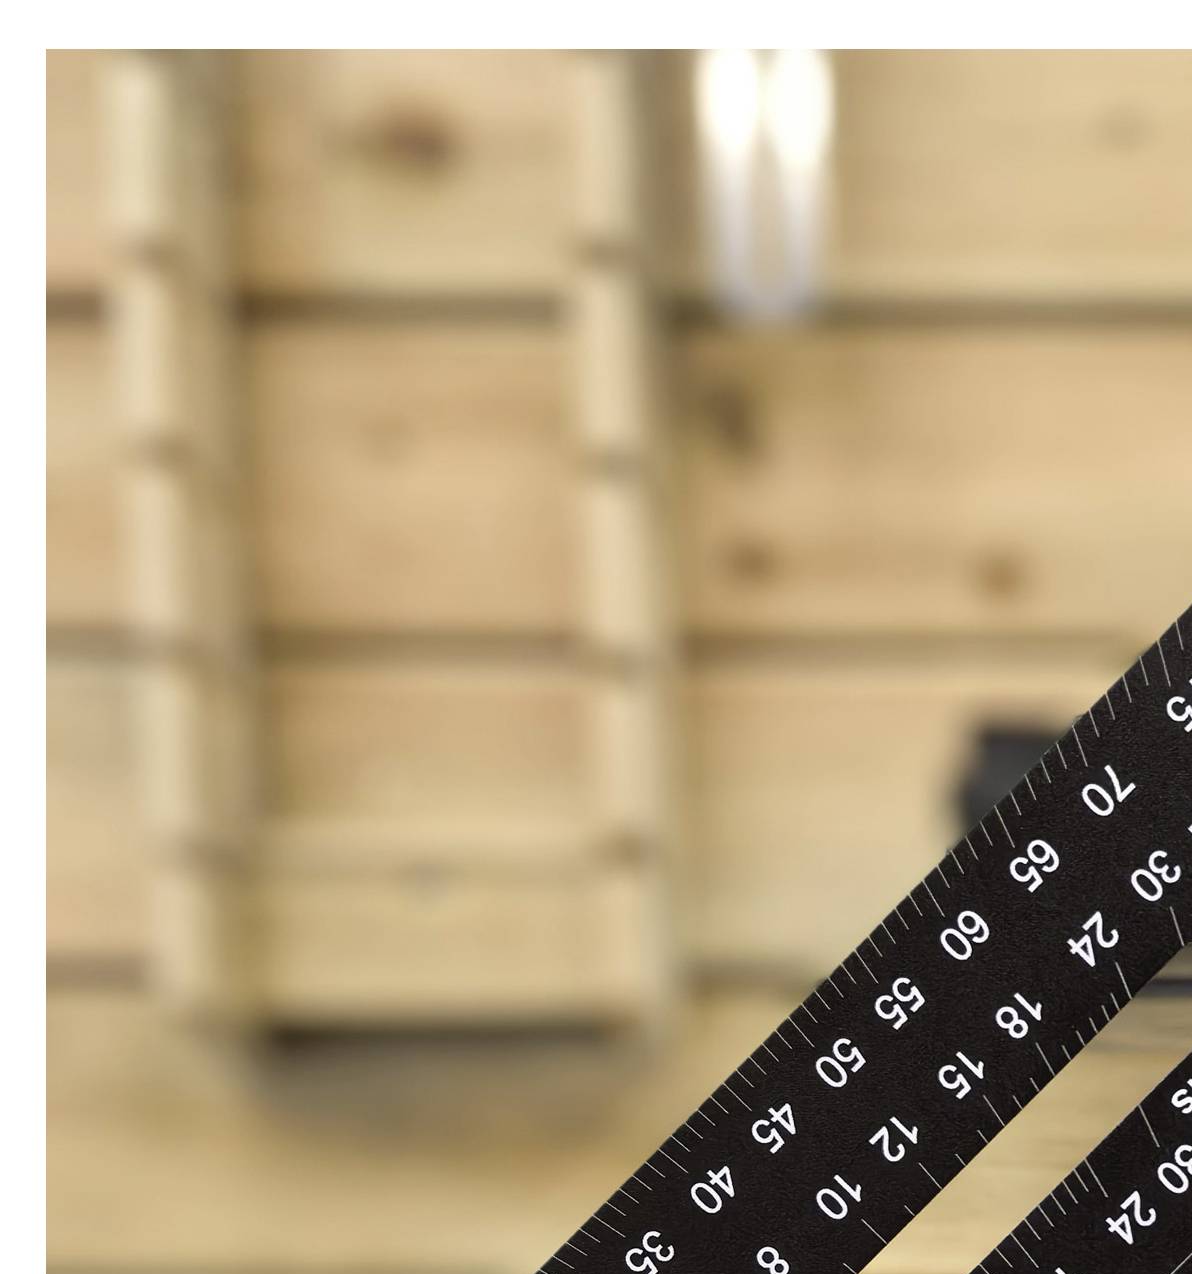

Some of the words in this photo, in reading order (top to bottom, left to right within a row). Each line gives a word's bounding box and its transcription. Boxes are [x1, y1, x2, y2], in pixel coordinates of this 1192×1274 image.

[1082, 765, 1136, 816] 70
[1010, 840, 1059, 892] 65
[1131, 851, 1181, 901] 30
[940, 911, 989, 960] 60
[1067, 911, 1119, 967] 24
[875, 978, 925, 1030] 55
[996, 993, 1042, 1038] 18
[816, 1038, 866, 1087] 50
[939, 1052, 984, 1099] 15
[752, 1103, 796, 1153] 45
[869, 1117, 918, 1161] 12
[691, 1166, 734, 1213] 40
[816, 1175, 861, 1219] 10
[1106, 1191, 1156, 1244] 24
